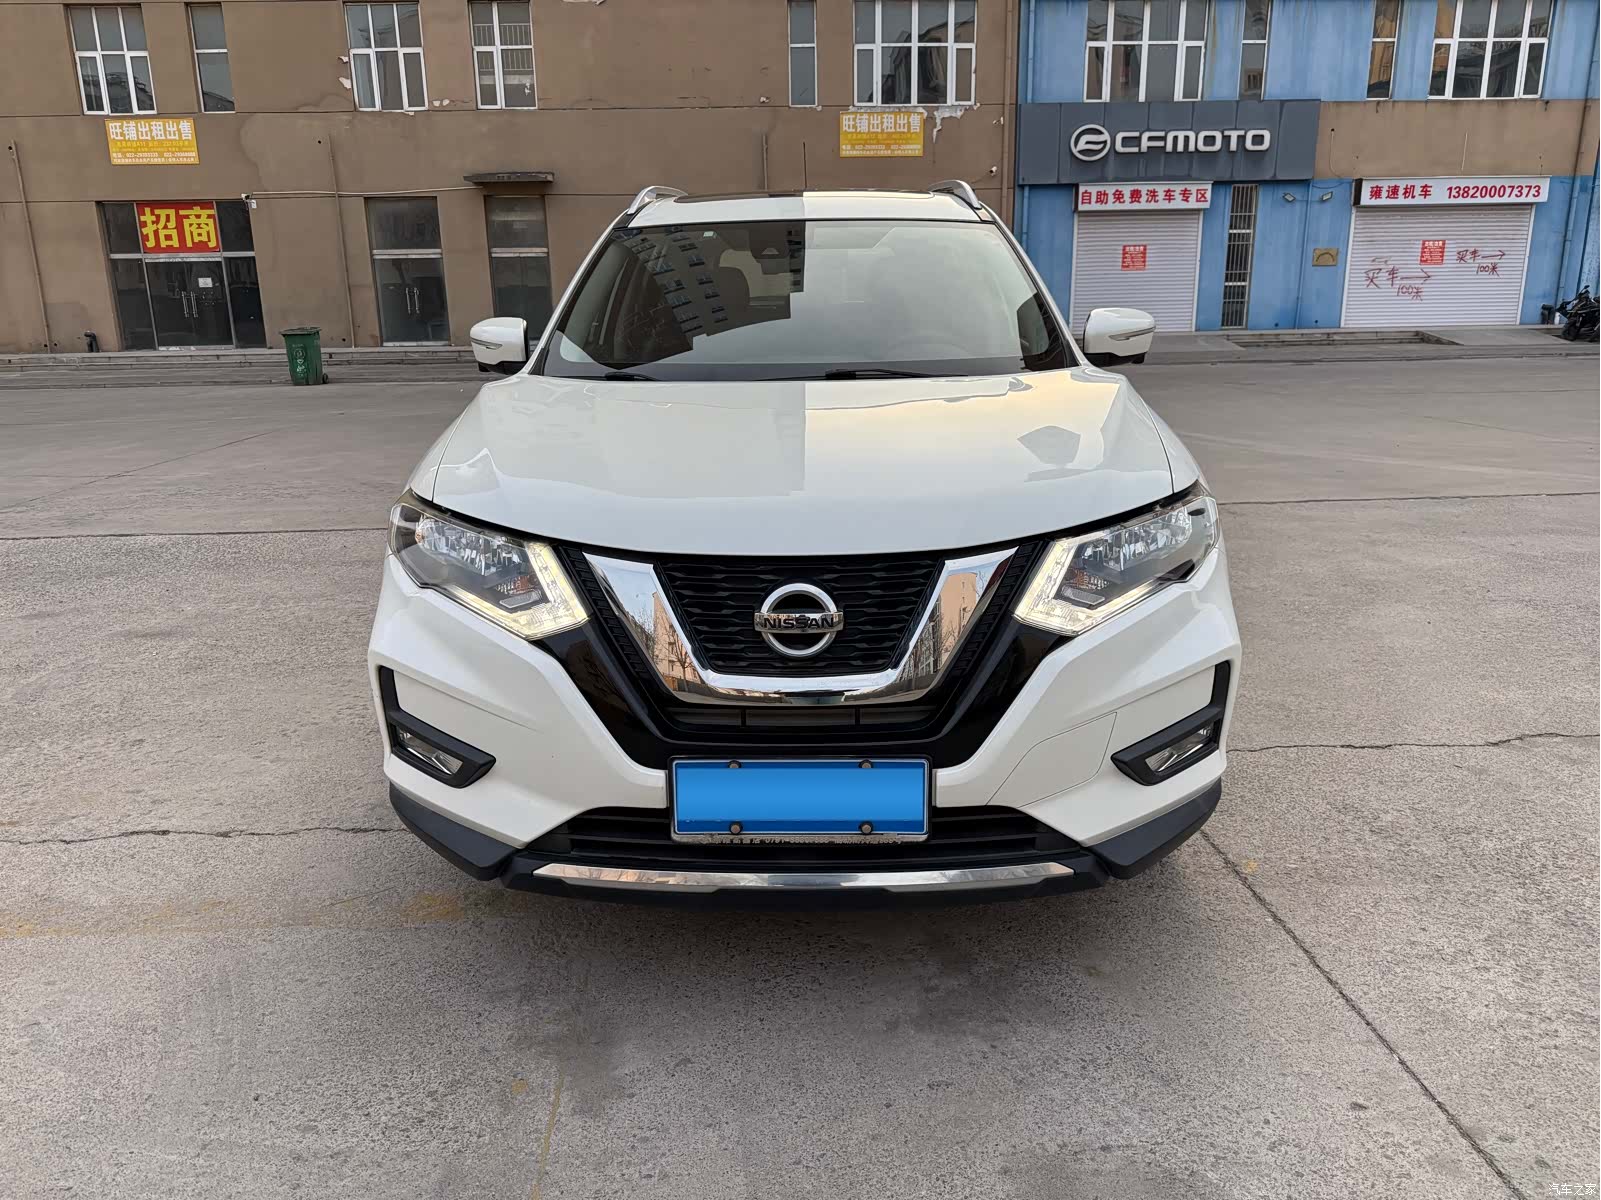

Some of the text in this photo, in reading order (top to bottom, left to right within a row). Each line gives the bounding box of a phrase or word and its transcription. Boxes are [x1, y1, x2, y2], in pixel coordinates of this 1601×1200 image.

[109, 120, 192, 140] 旺铺出租出售
[843, 113, 920, 133] 旺铺出租出售
[1115, 129, 1271, 153] CFMOTO
[1080, 187, 1209, 205] 自助免费洗车专区
[1369, 184, 1541, 200] 雍速机车 13820007373
[140, 206, 218, 248] 招商
[763, 616, 834, 629] NISSAN
